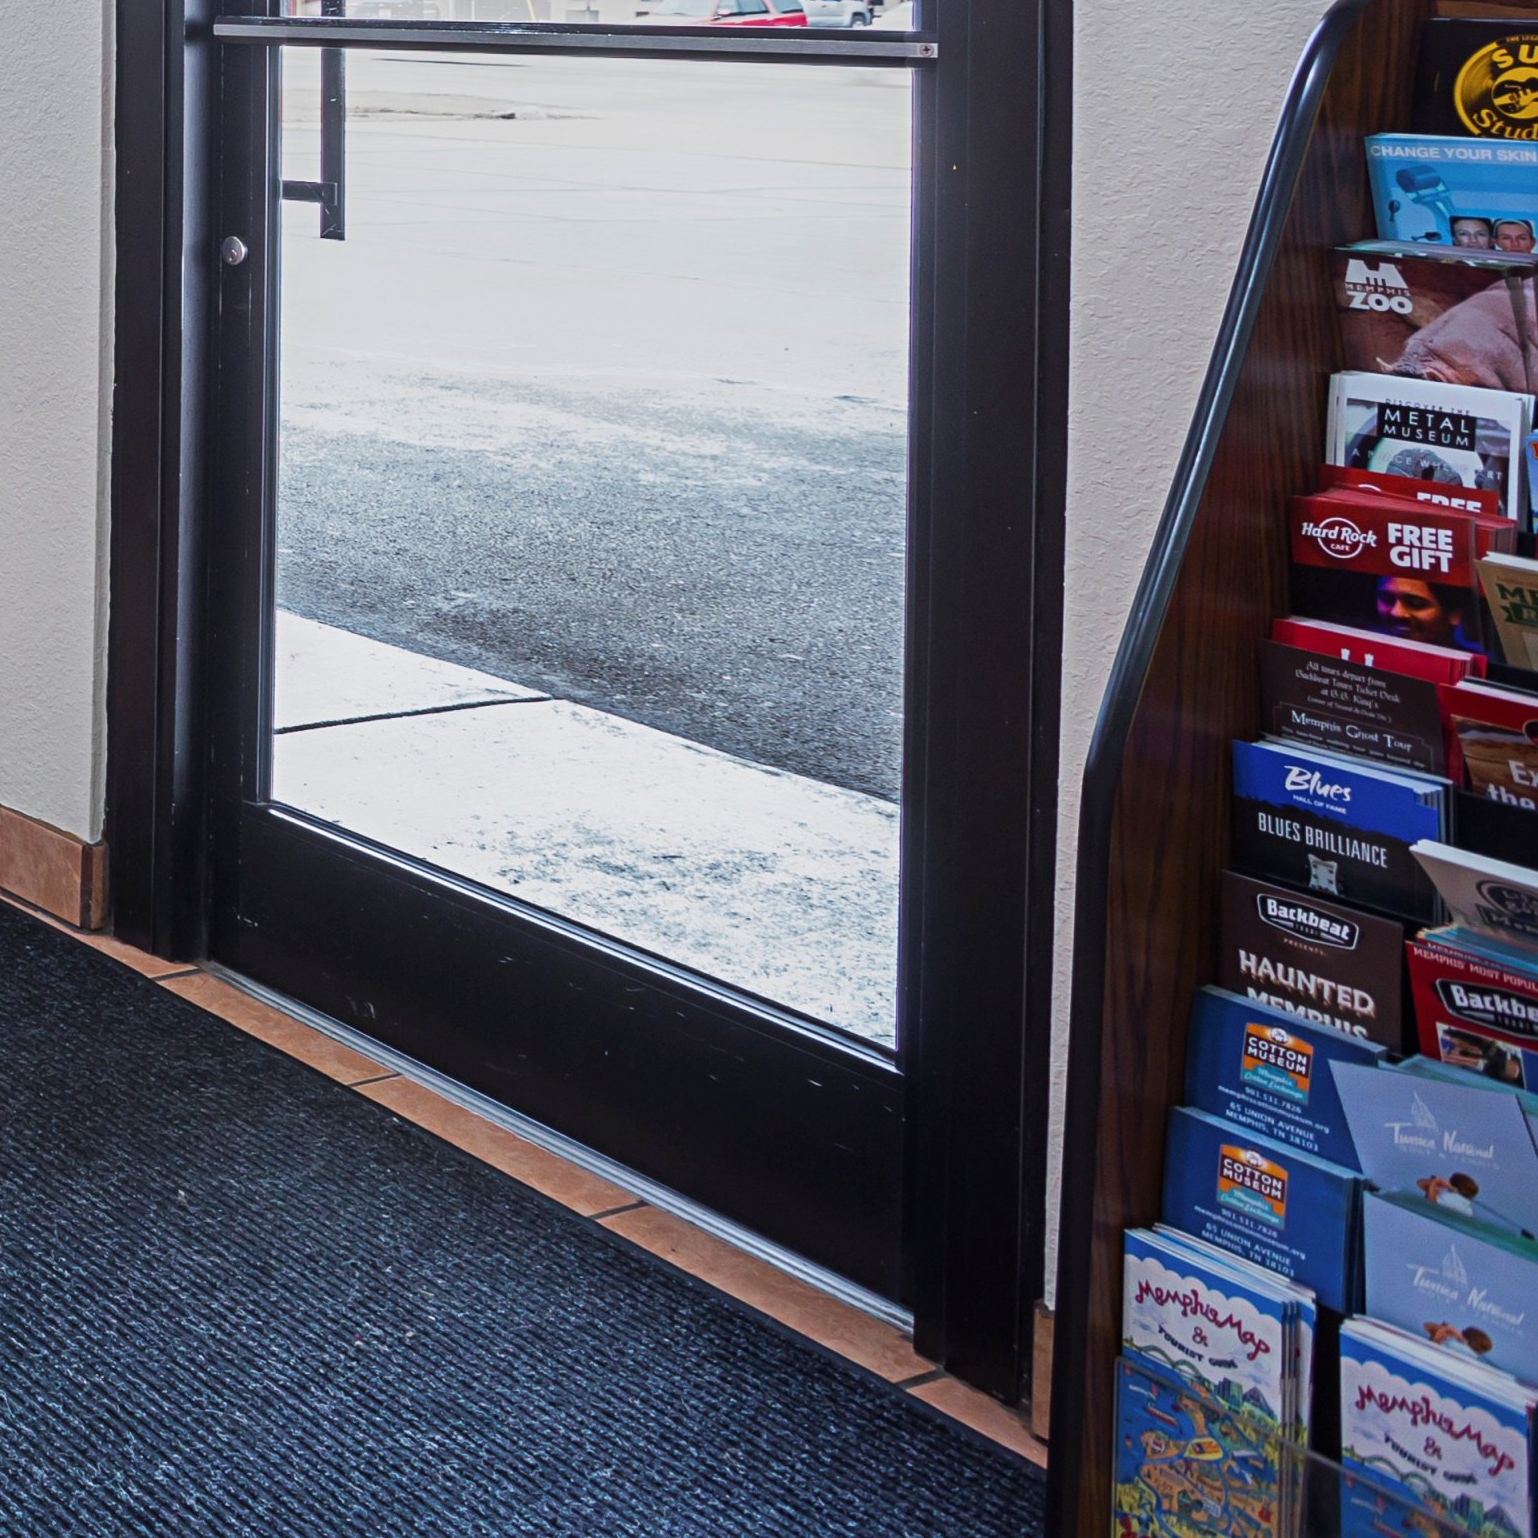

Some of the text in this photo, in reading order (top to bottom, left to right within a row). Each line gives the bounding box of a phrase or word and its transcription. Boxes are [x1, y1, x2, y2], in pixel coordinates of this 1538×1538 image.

[1369, 145, 1537, 162] CHANGE YOUR SKIN
[1345, 283, 1411, 297] MEMPHIS
[1346, 290, 1413, 314] ZOO
[1383, 424, 1469, 447] MUSEUM
[1384, 410, 1470, 433] METAL
[1301, 522, 1377, 547] Hard Rock
[1387, 522, 1453, 551] FREE
[1389, 545, 1453, 573] GIFT
[1306, 661, 1319, 672] All
[1332, 679, 1353, 691] Tours
[1356, 684, 1378, 698] Ticket
[1291, 709, 1342, 733] Memphis
[1345, 724, 1378, 743] Ghost
[1382, 733, 1413, 753] Tour
[1284, 765, 1352, 802] Blues
[1292, 794, 1347, 815] HALL OF FAME
[1257, 811, 1388, 869] BLUES BRILLIANCE
[1266, 898, 1351, 940] Backbeat
[1238, 949, 1376, 1016] HAUNTED
[1469, 962, 1501, 981] MOST
[1247, 1046, 1306, 1075] MUSEUM
[1248, 1036, 1307, 1065] COTTON
[1225, 1109, 1269, 1134] MEMPHIS,
[1273, 1127, 1286, 1139] TN
[1244, 1107, 1275, 1125] UNION
[1277, 1120, 1315, 1141] AVENUE
[1443, 1129, 1495, 1159] National
[1222, 1167, 1282, 1200] MUSEUM
[1223, 1158, 1283, 1190] COTTON
[1220, 1228, 1251, 1249] UNION
[1253, 1243, 1291, 1266] AVENUE
[1249, 1250, 1262, 1262] TN
[1135, 1279, 1271, 1361] Memphis Map
[1157, 1324, 1205, 1362] TOURIST
[1192, 1325, 1209, 1348] &
[1355, 1384, 1515, 1477] Memphis Map
[1383, 1431, 1438, 1476] TOURIST
[1423, 1435, 1443, 1461] &
